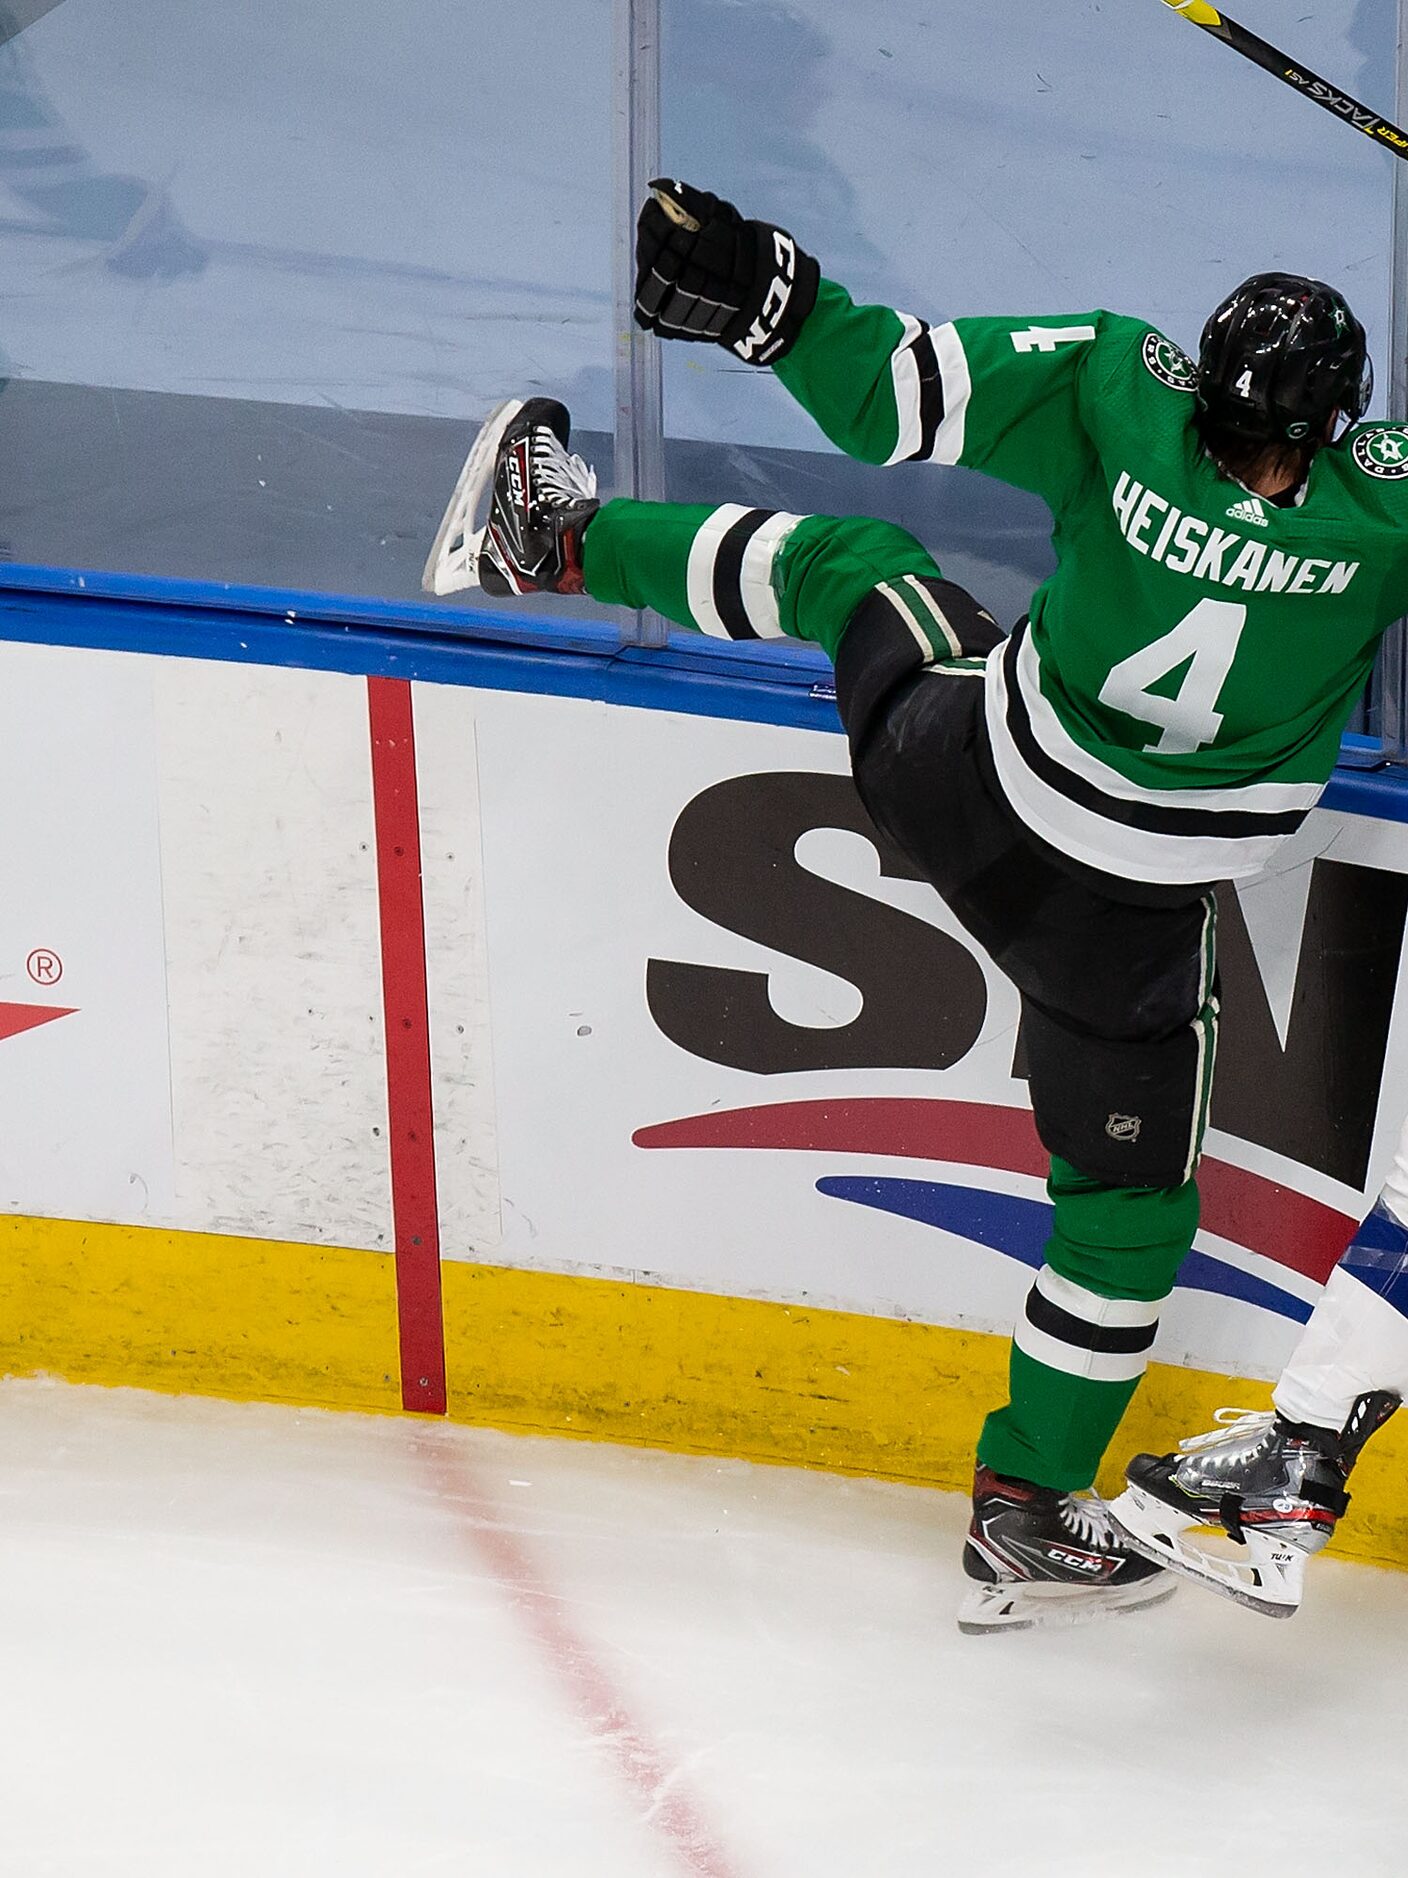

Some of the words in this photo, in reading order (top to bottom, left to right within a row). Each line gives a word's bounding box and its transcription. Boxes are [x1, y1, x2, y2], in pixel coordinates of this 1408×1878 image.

[1308, 81, 1380, 135] TACKS
[733, 230, 796, 360] CCM
[1235, 369, 1253, 398] 4
[508, 455, 525, 507] CCM
[1112, 470, 1361, 594] HEISKANEN
[1225, 506, 1269, 528] adidas
[1097, 597, 1247, 754] 4
[1047, 1549, 1103, 1572] CCM
